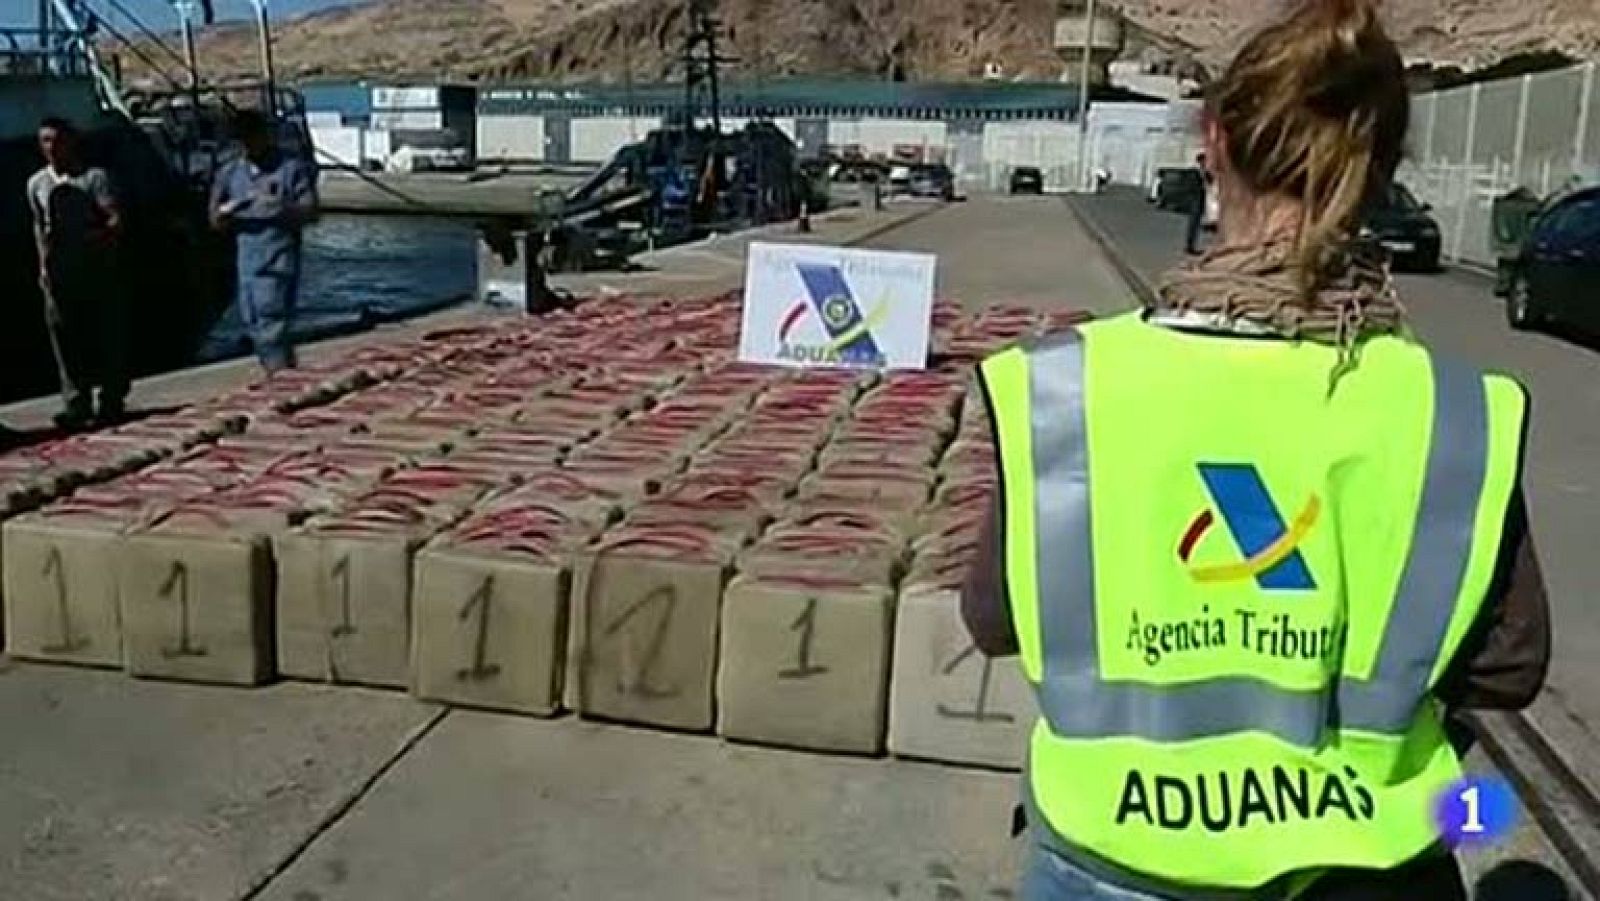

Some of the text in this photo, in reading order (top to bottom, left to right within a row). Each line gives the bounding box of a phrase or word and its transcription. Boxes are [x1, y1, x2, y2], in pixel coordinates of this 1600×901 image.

[777, 342, 888, 368] ADUA
[40, 545, 91, 652] 1
[158, 559, 206, 658] 1
[331, 553, 357, 637] 1
[457, 574, 501, 682] 1
[1126, 603, 1227, 666] Agencia
[777, 598, 829, 678] 1
[1115, 765, 1375, 832] ADUANAS
